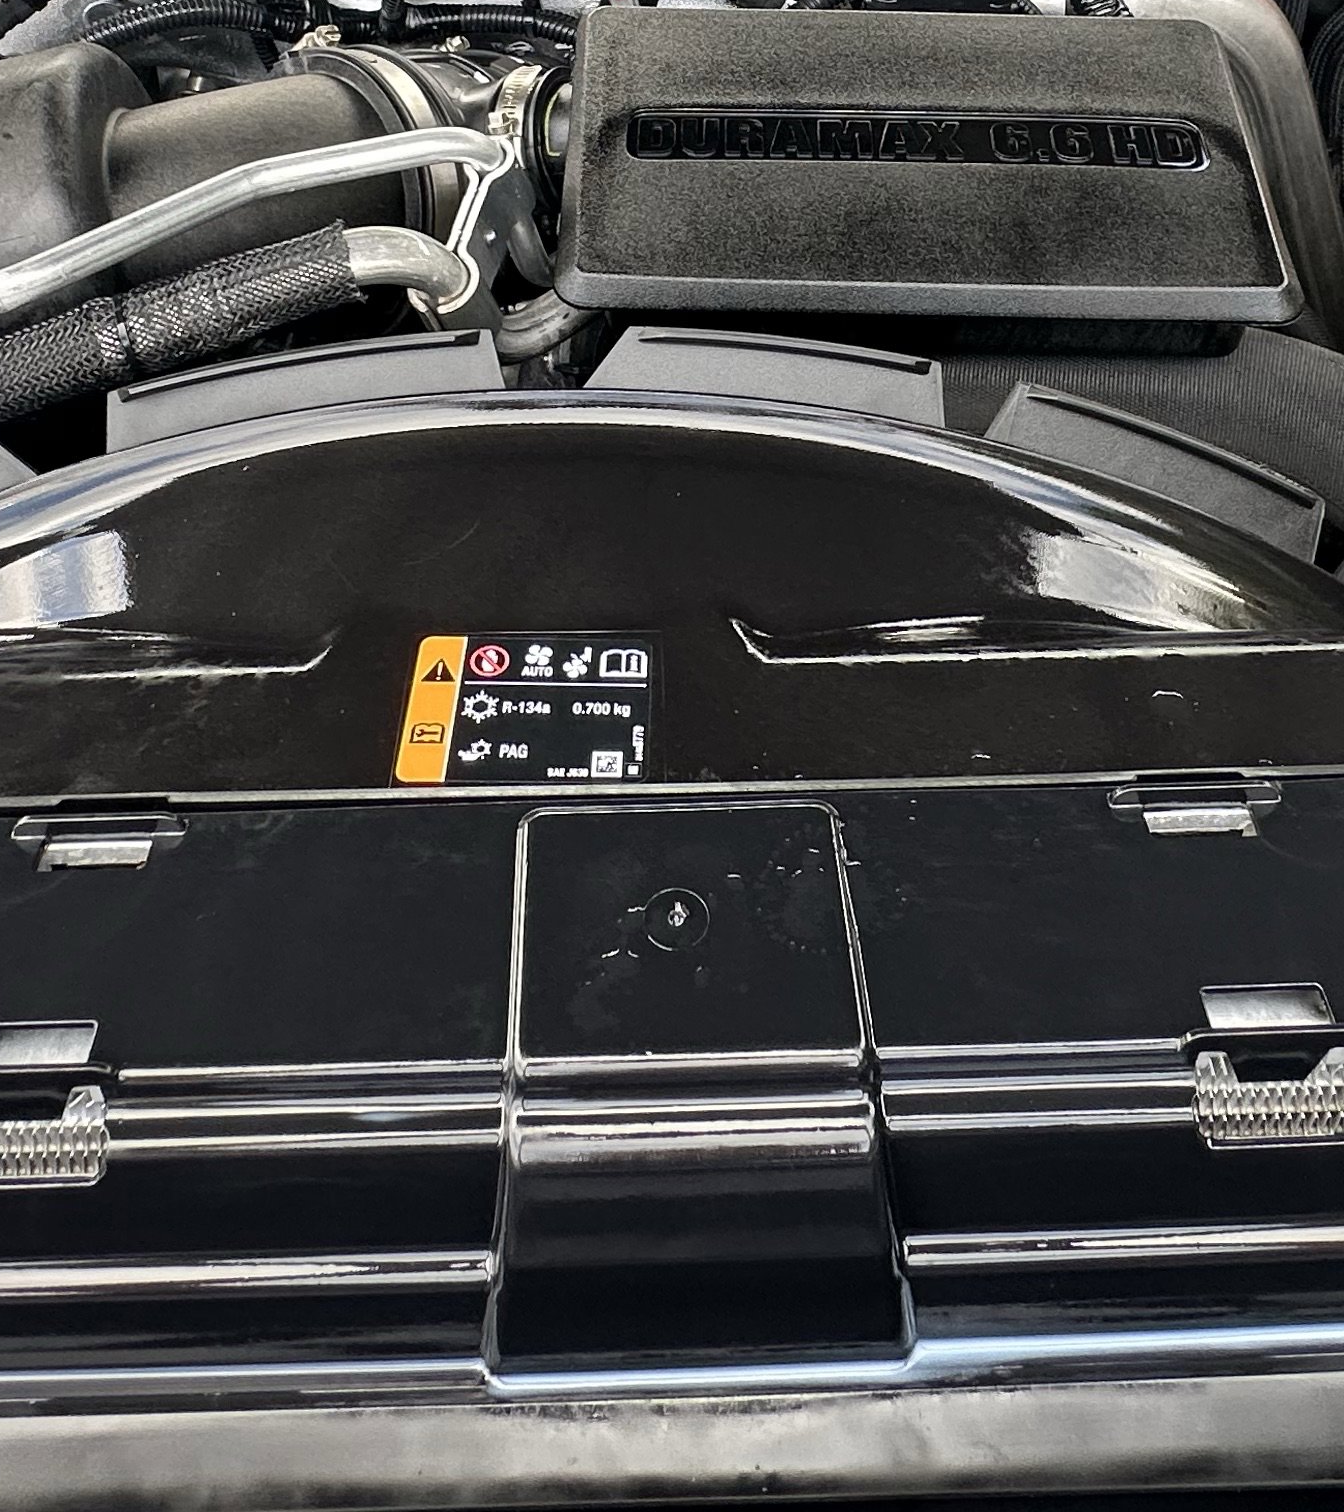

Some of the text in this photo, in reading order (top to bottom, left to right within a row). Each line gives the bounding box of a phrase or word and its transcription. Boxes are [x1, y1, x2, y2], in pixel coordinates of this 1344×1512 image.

[637, 118, 1197, 167] DURAMAX 6.6 HD
[521, 666, 553, 677] AUTO
[502, 701, 631, 717] R-134a 0.700 kg
[498, 743, 529, 759] PAG
